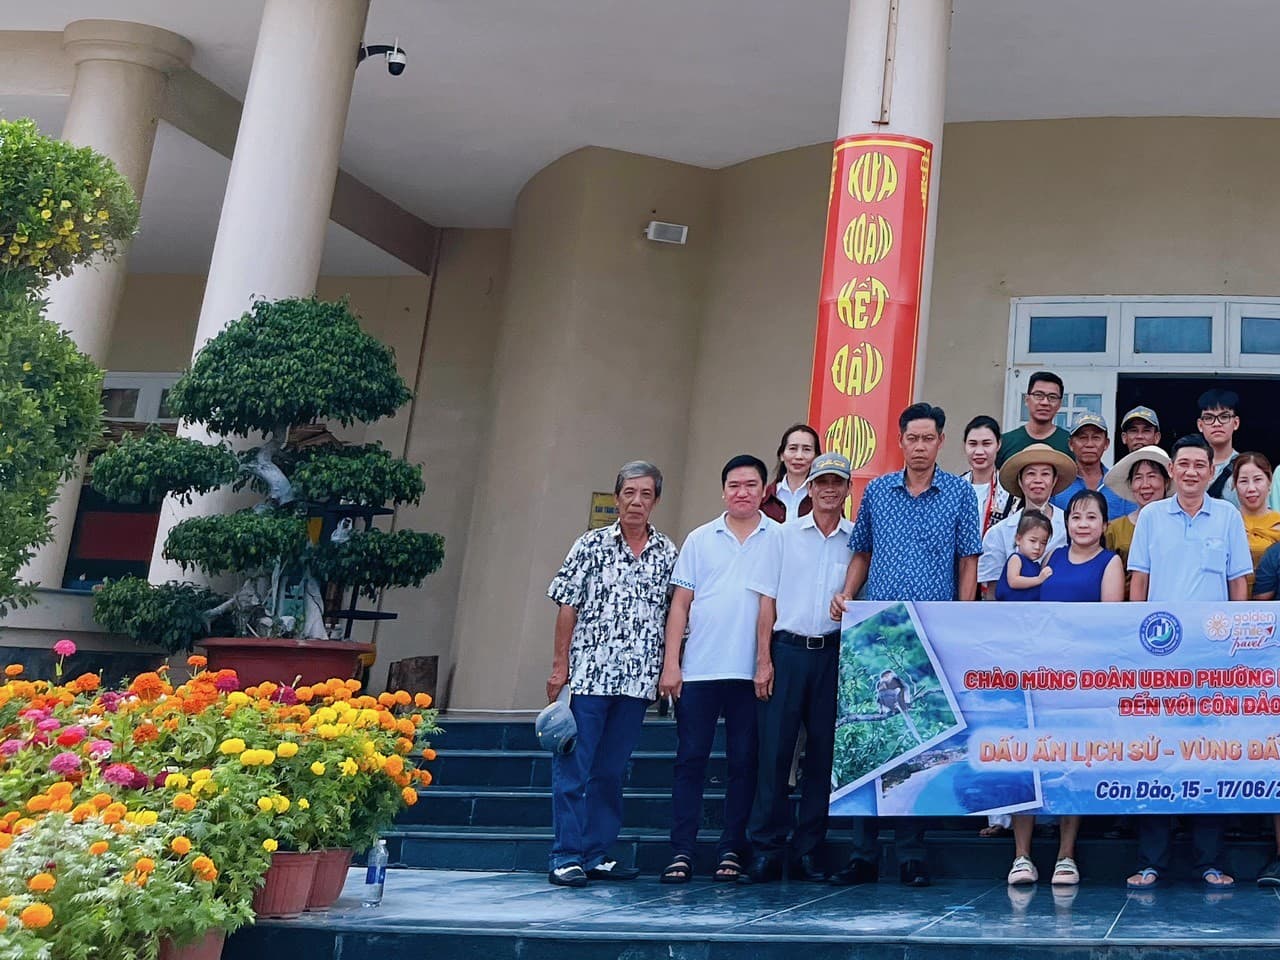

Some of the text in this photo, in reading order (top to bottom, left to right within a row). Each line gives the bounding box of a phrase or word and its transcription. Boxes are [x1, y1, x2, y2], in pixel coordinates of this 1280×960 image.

[843, 211, 893, 265] ĐOÀN
[837, 275, 890, 330] KẾT
[831, 341, 884, 396] ĐẤU
[825, 414, 877, 471] TRANH
[1234, 611, 1273, 625] golden
[1234, 625, 1263, 636] smile
[965, 667, 1019, 689] CHÀO
[1021, 666, 1077, 690] MỪNG
[1080, 666, 1135, 689] ĐOÀN
[1139, 669, 1193, 689] UBND
[1196, 665, 1275, 688] PHƯỜNG
[1119, 691, 1160, 716] ĐẾN
[1162, 692, 1196, 716] VỚI
[1198, 692, 1239, 715] CÔN
[980, 735, 1028, 762] DẤU
[1032, 735, 1066, 762] ẤN
[1071, 740, 1123, 767] LỊCH
[1127, 734, 1161, 762] SỬ
[1179, 737, 1242, 761] VÙNG
[1096, 780, 1131, 799] Côn
[1136, 778, 1176, 800] Đảo,
[1181, 780, 1201, 798] 15
